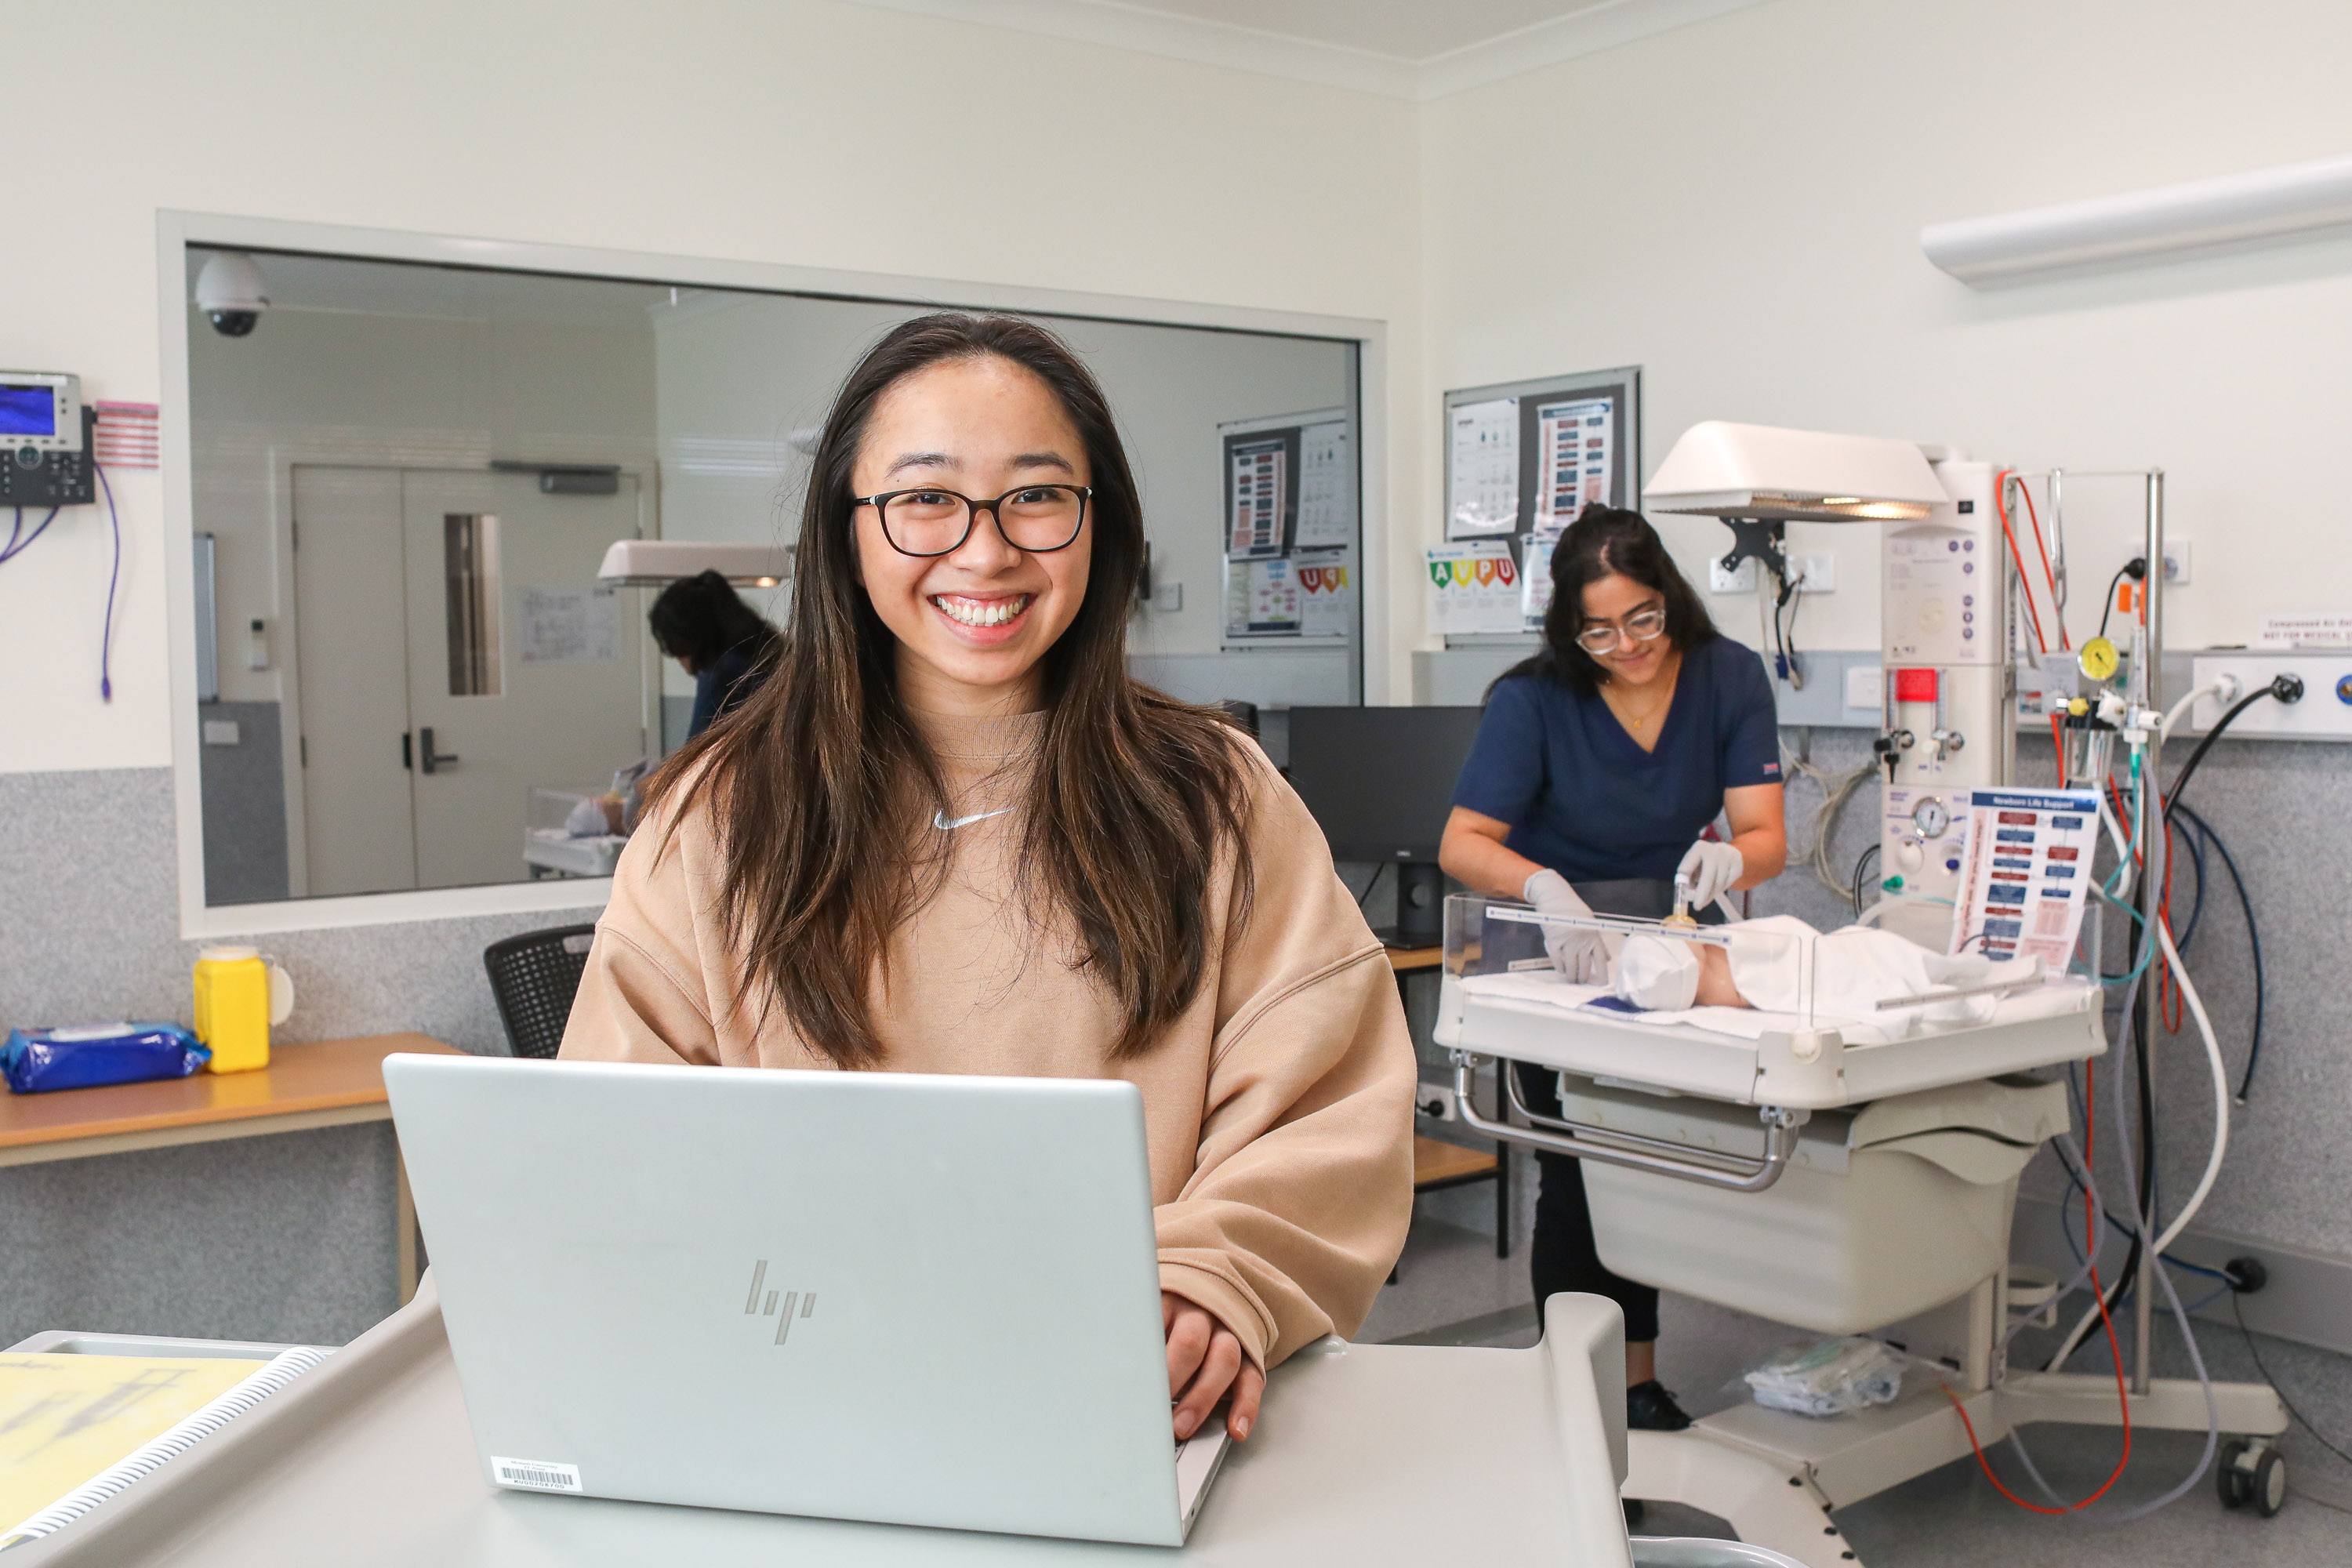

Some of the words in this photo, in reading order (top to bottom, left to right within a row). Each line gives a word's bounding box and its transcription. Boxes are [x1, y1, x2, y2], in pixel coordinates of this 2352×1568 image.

[1435, 563, 1449, 581] A
[1457, 562, 1470, 579] V
[1479, 561, 1492, 579] P
[1499, 560, 1512, 579] U
[2283, 631, 2299, 640] FOR
[1993, 796, 2027, 807] Newborn
[2027, 797, 2042, 808] Life
[2043, 798, 2074, 810] Support
[745, 1260, 817, 1345] hp
